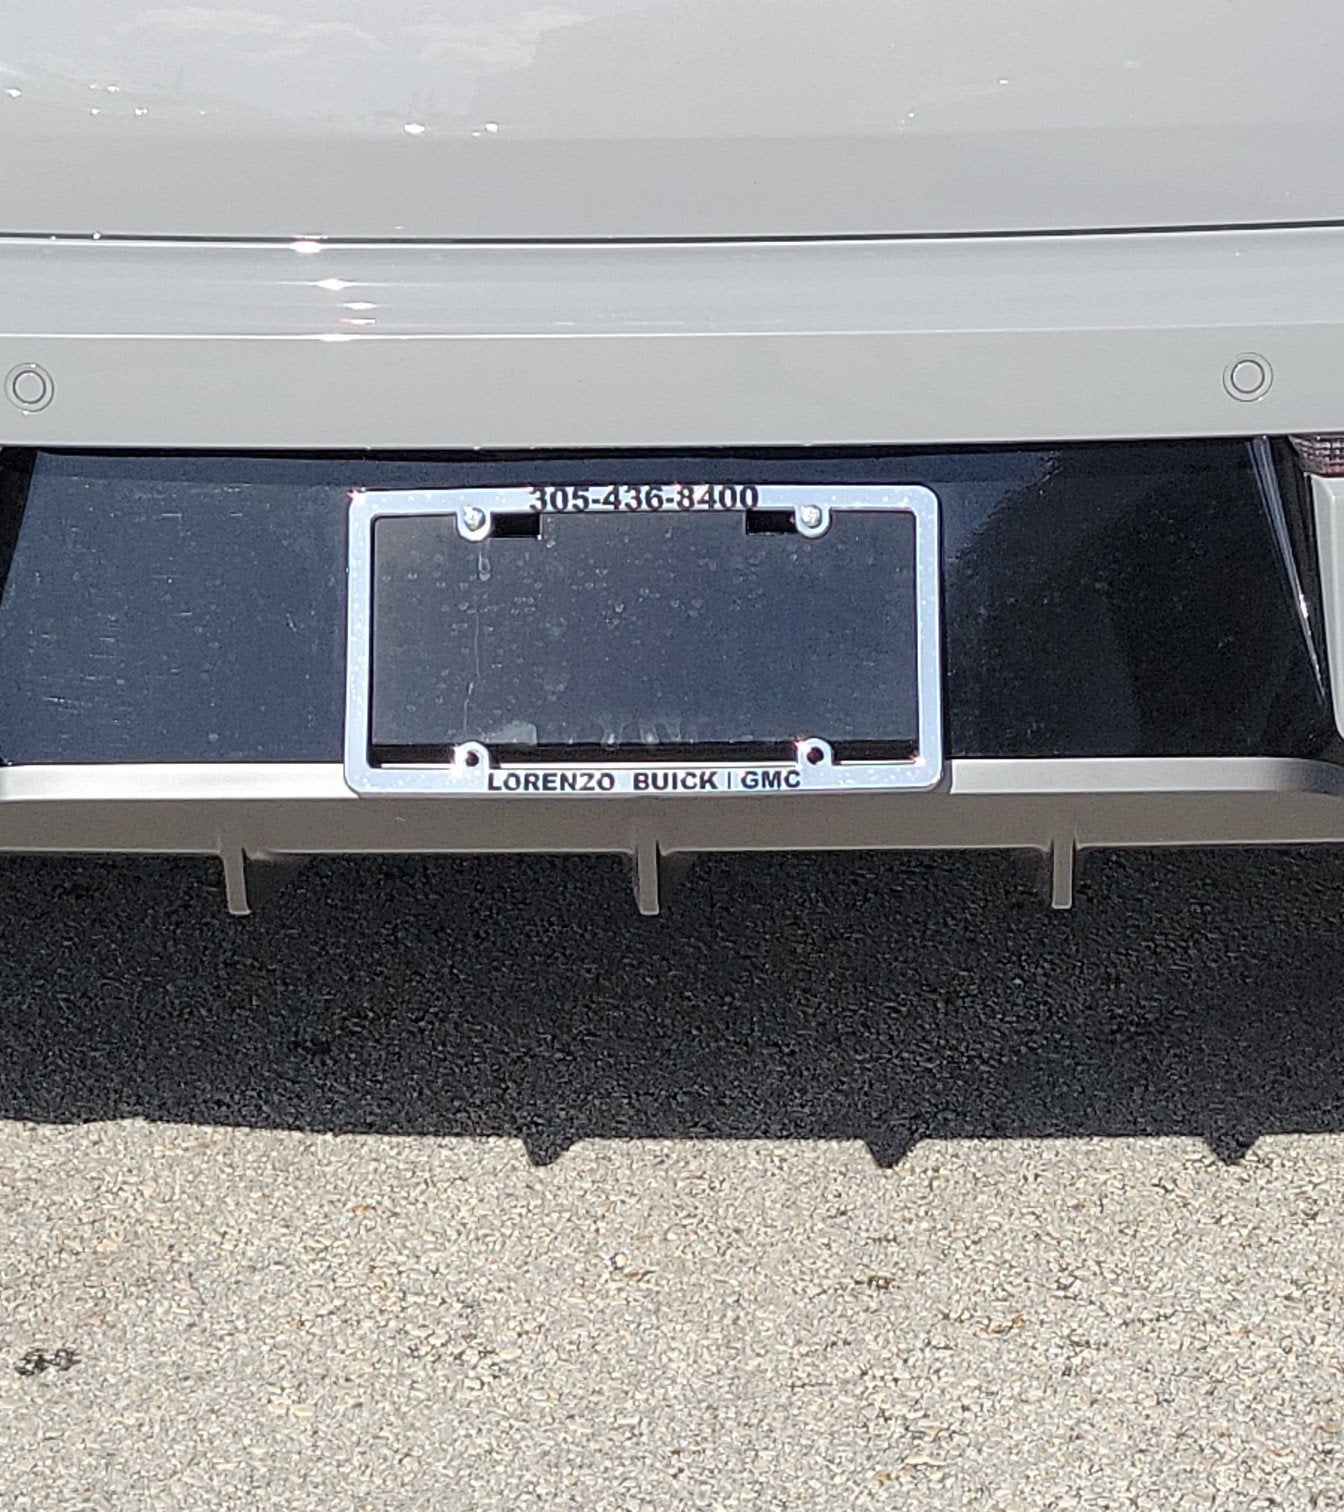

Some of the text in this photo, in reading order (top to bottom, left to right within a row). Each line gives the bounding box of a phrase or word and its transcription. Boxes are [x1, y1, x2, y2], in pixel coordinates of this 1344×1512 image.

[529, 484, 759, 512] 305-436-8400
[487, 768, 802, 792] LORENZO BUICK GMC
